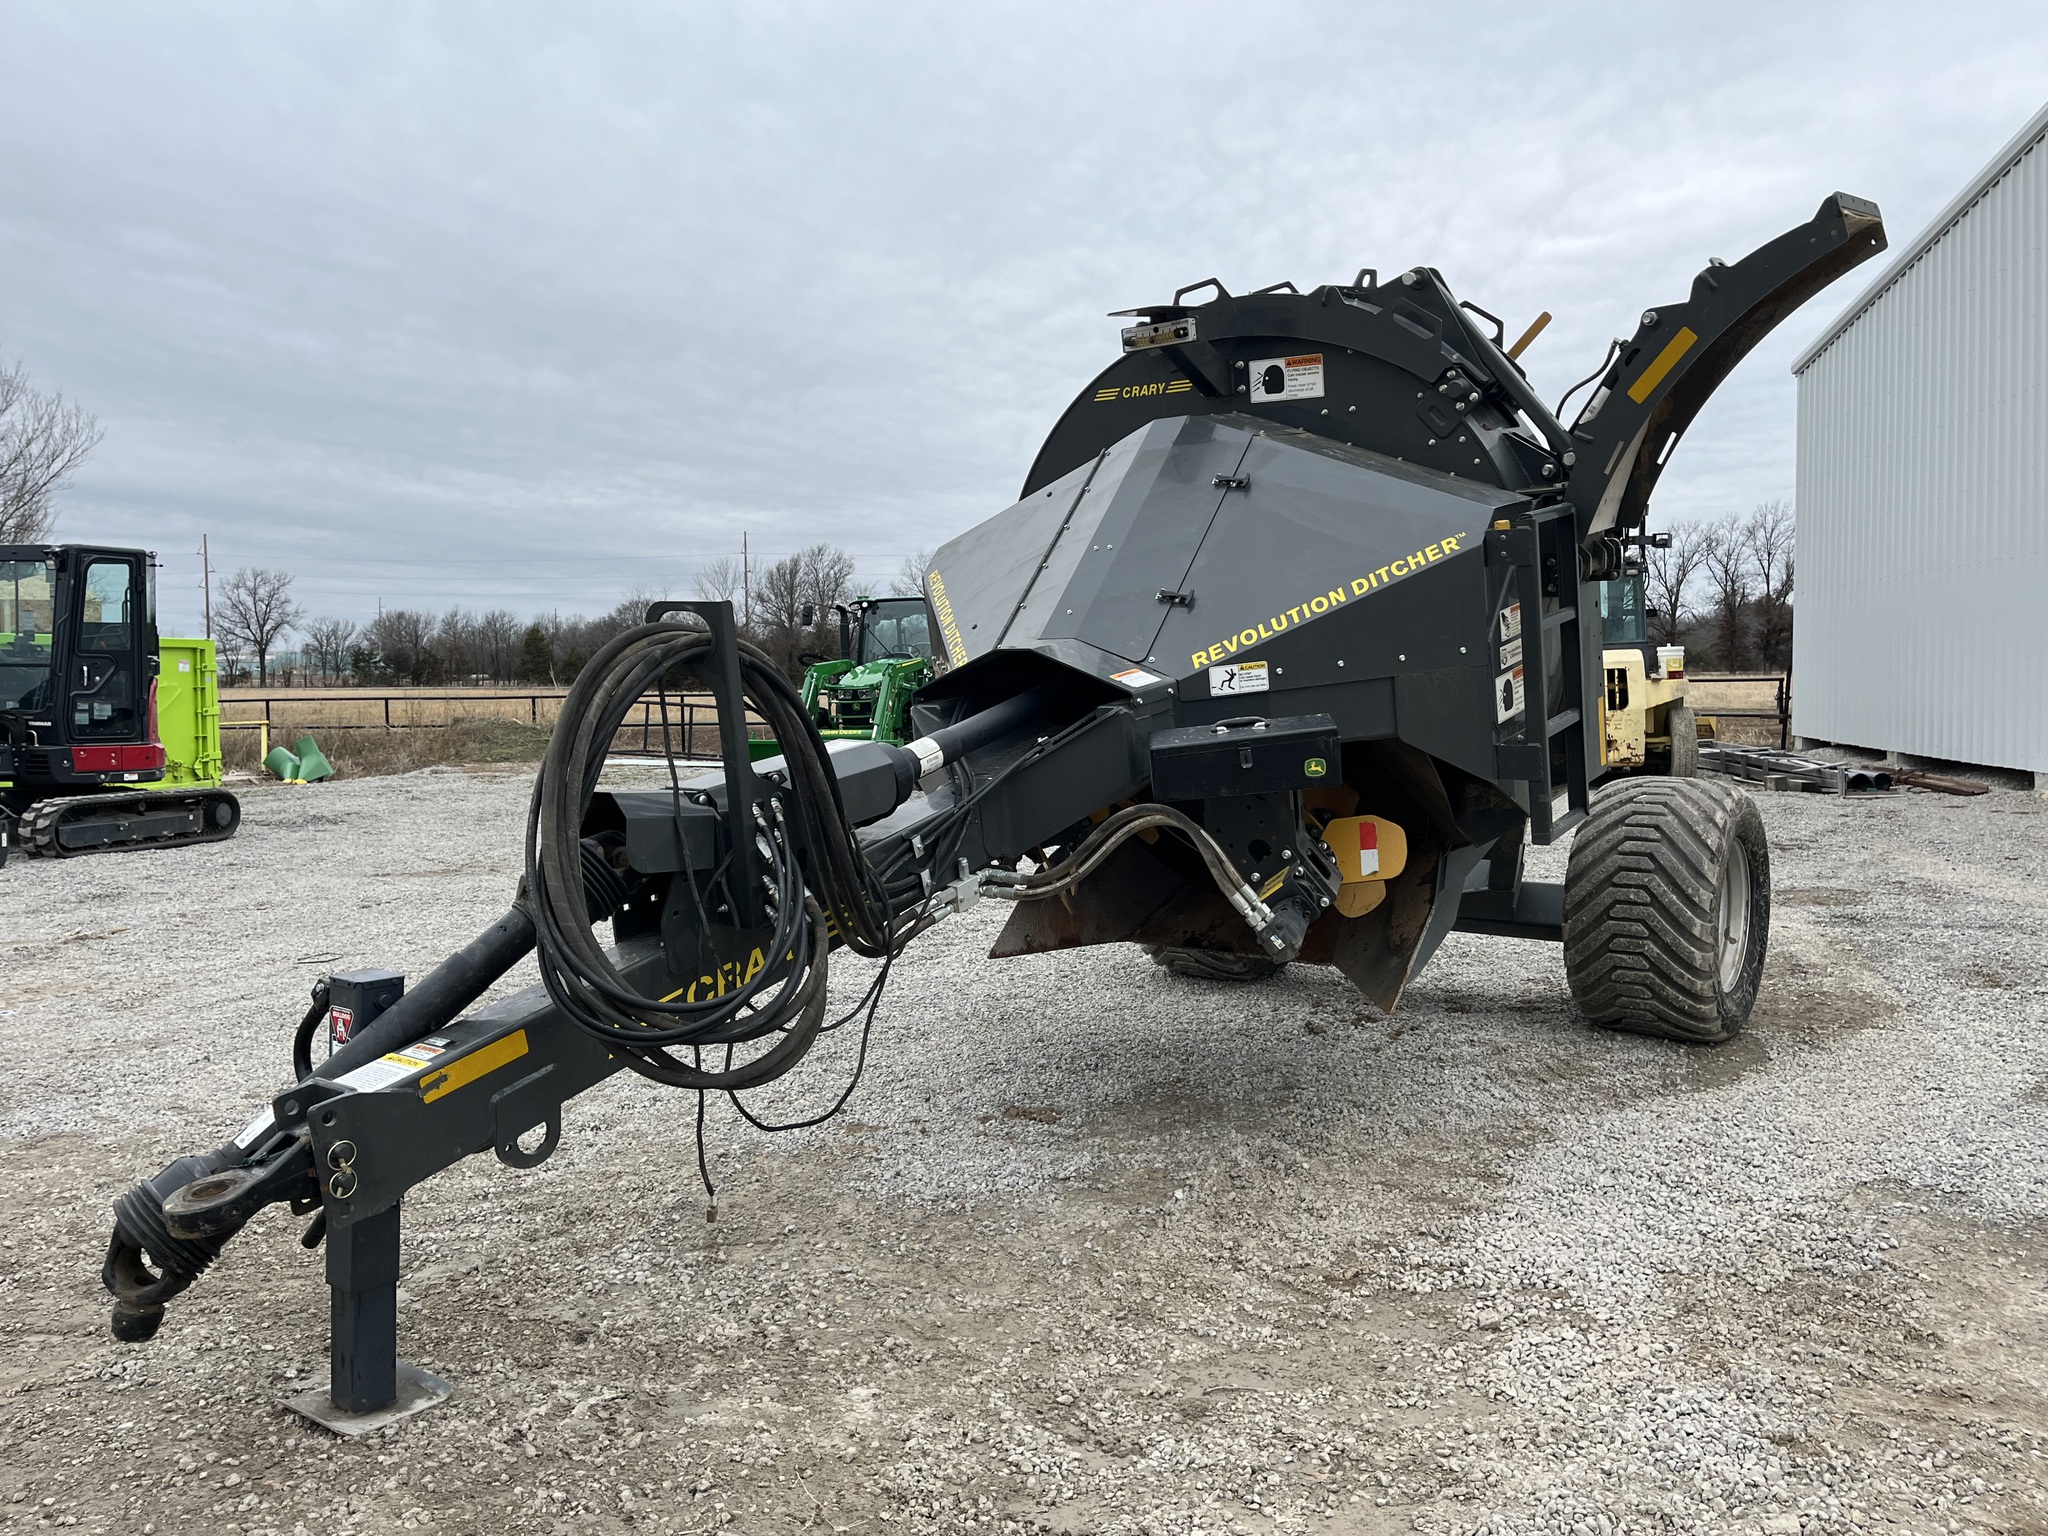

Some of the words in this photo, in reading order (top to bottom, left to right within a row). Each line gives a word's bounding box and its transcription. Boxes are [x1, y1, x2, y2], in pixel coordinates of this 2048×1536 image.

[1292, 357, 1321, 365] WARNING
[1122, 382, 1166, 398] CRARY
[927, 569, 955, 627] REVOLUTION
[944, 622, 968, 667] DITCHER
[1191, 586, 1347, 669] REVOLUTION
